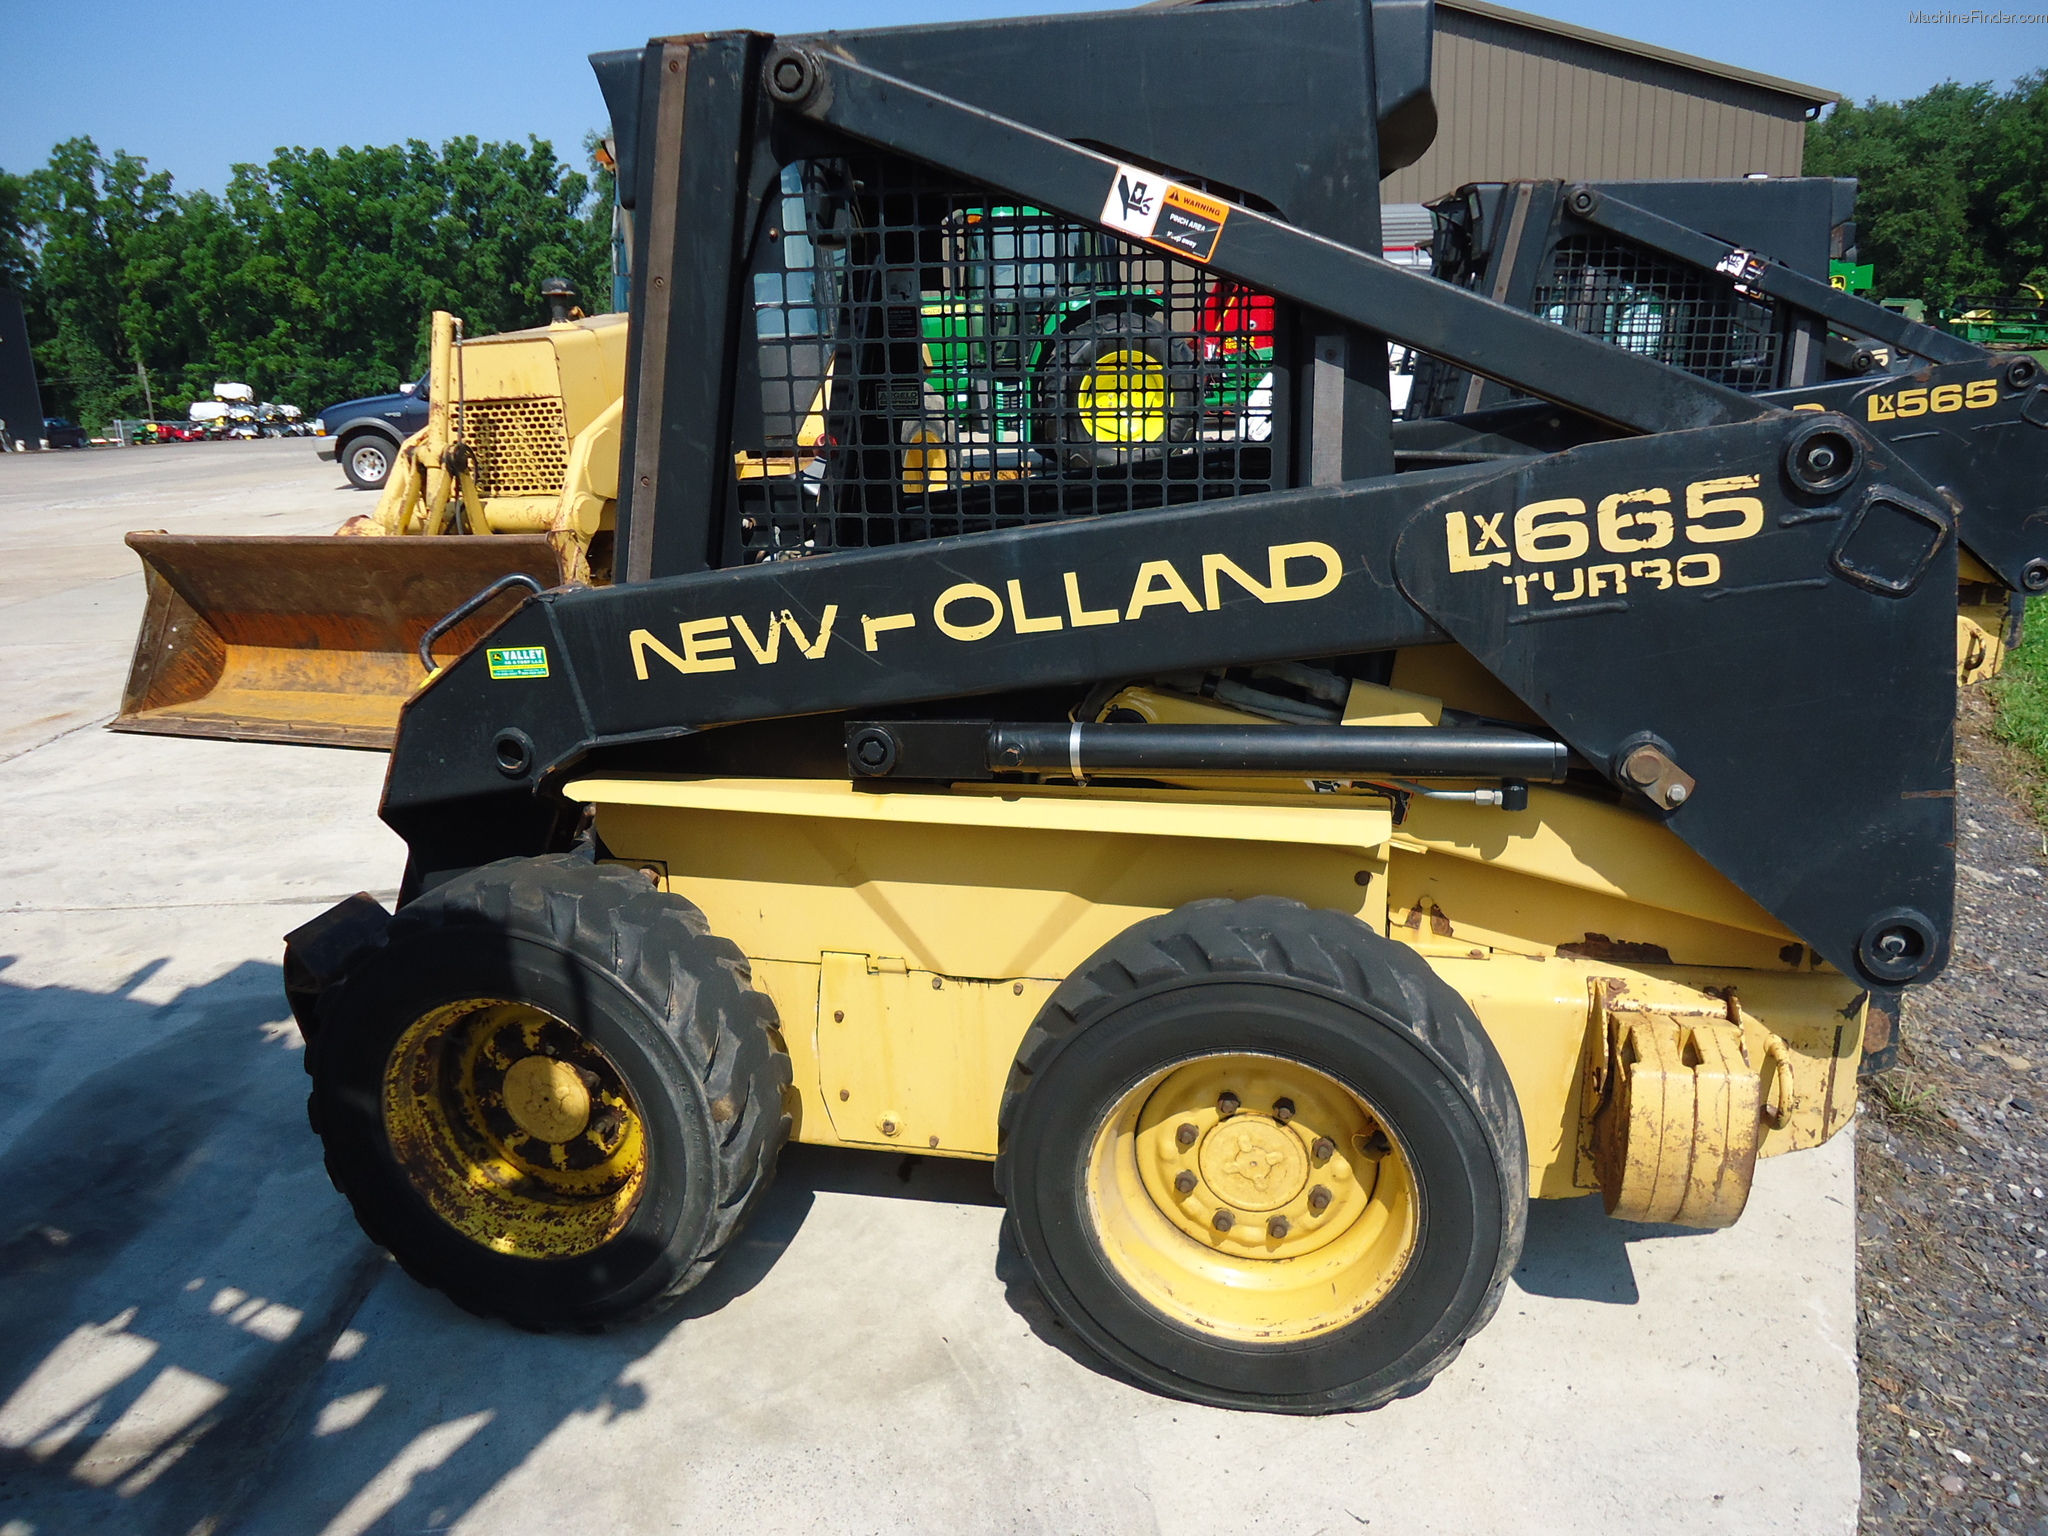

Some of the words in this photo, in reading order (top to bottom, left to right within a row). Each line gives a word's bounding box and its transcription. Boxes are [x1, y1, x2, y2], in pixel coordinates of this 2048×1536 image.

[1170, 212, 1190, 227] PINCH
[1188, 220, 1206, 232] AREA
[1182, 196, 1221, 217] WARNING
[1181, 237, 1197, 249] away
[1867, 379, 1998, 422] LX565
[1445, 473, 1765, 573] LX665
[1503, 553, 1721, 605] TURBO
[502, 649, 542, 661] VALLEY
[629, 604, 839, 681] NEW
